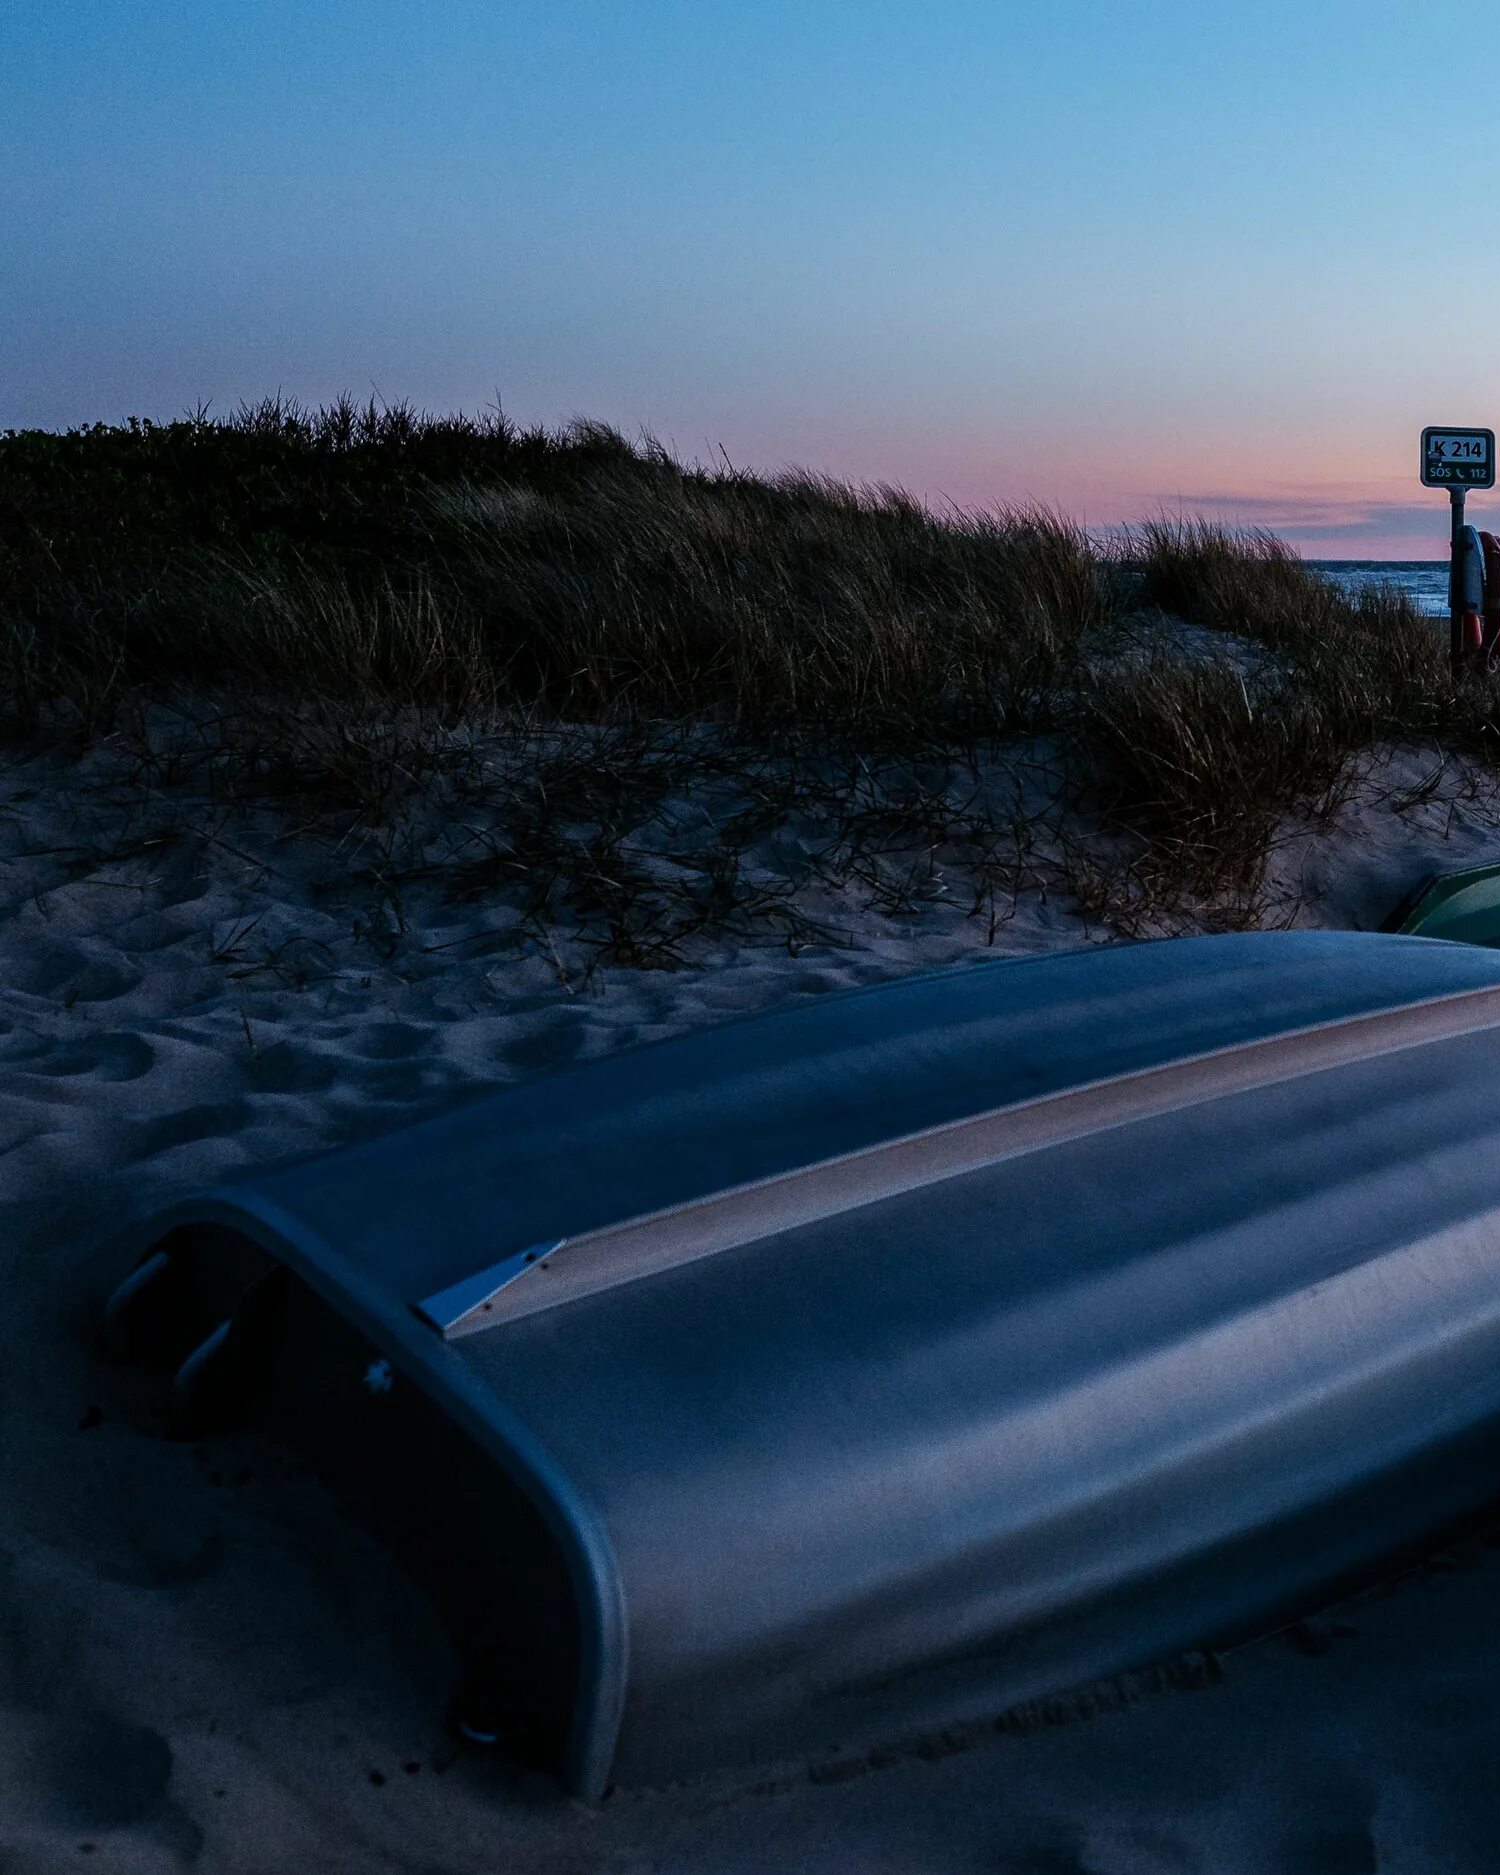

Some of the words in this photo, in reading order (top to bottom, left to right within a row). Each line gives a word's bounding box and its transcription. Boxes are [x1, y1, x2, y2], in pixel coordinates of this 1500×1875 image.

[1434, 440, 1447, 457] K
[1451, 441, 1482, 457] 214
[1430, 467, 1451, 477] SOS
[1470, 469, 1486, 479] 112
